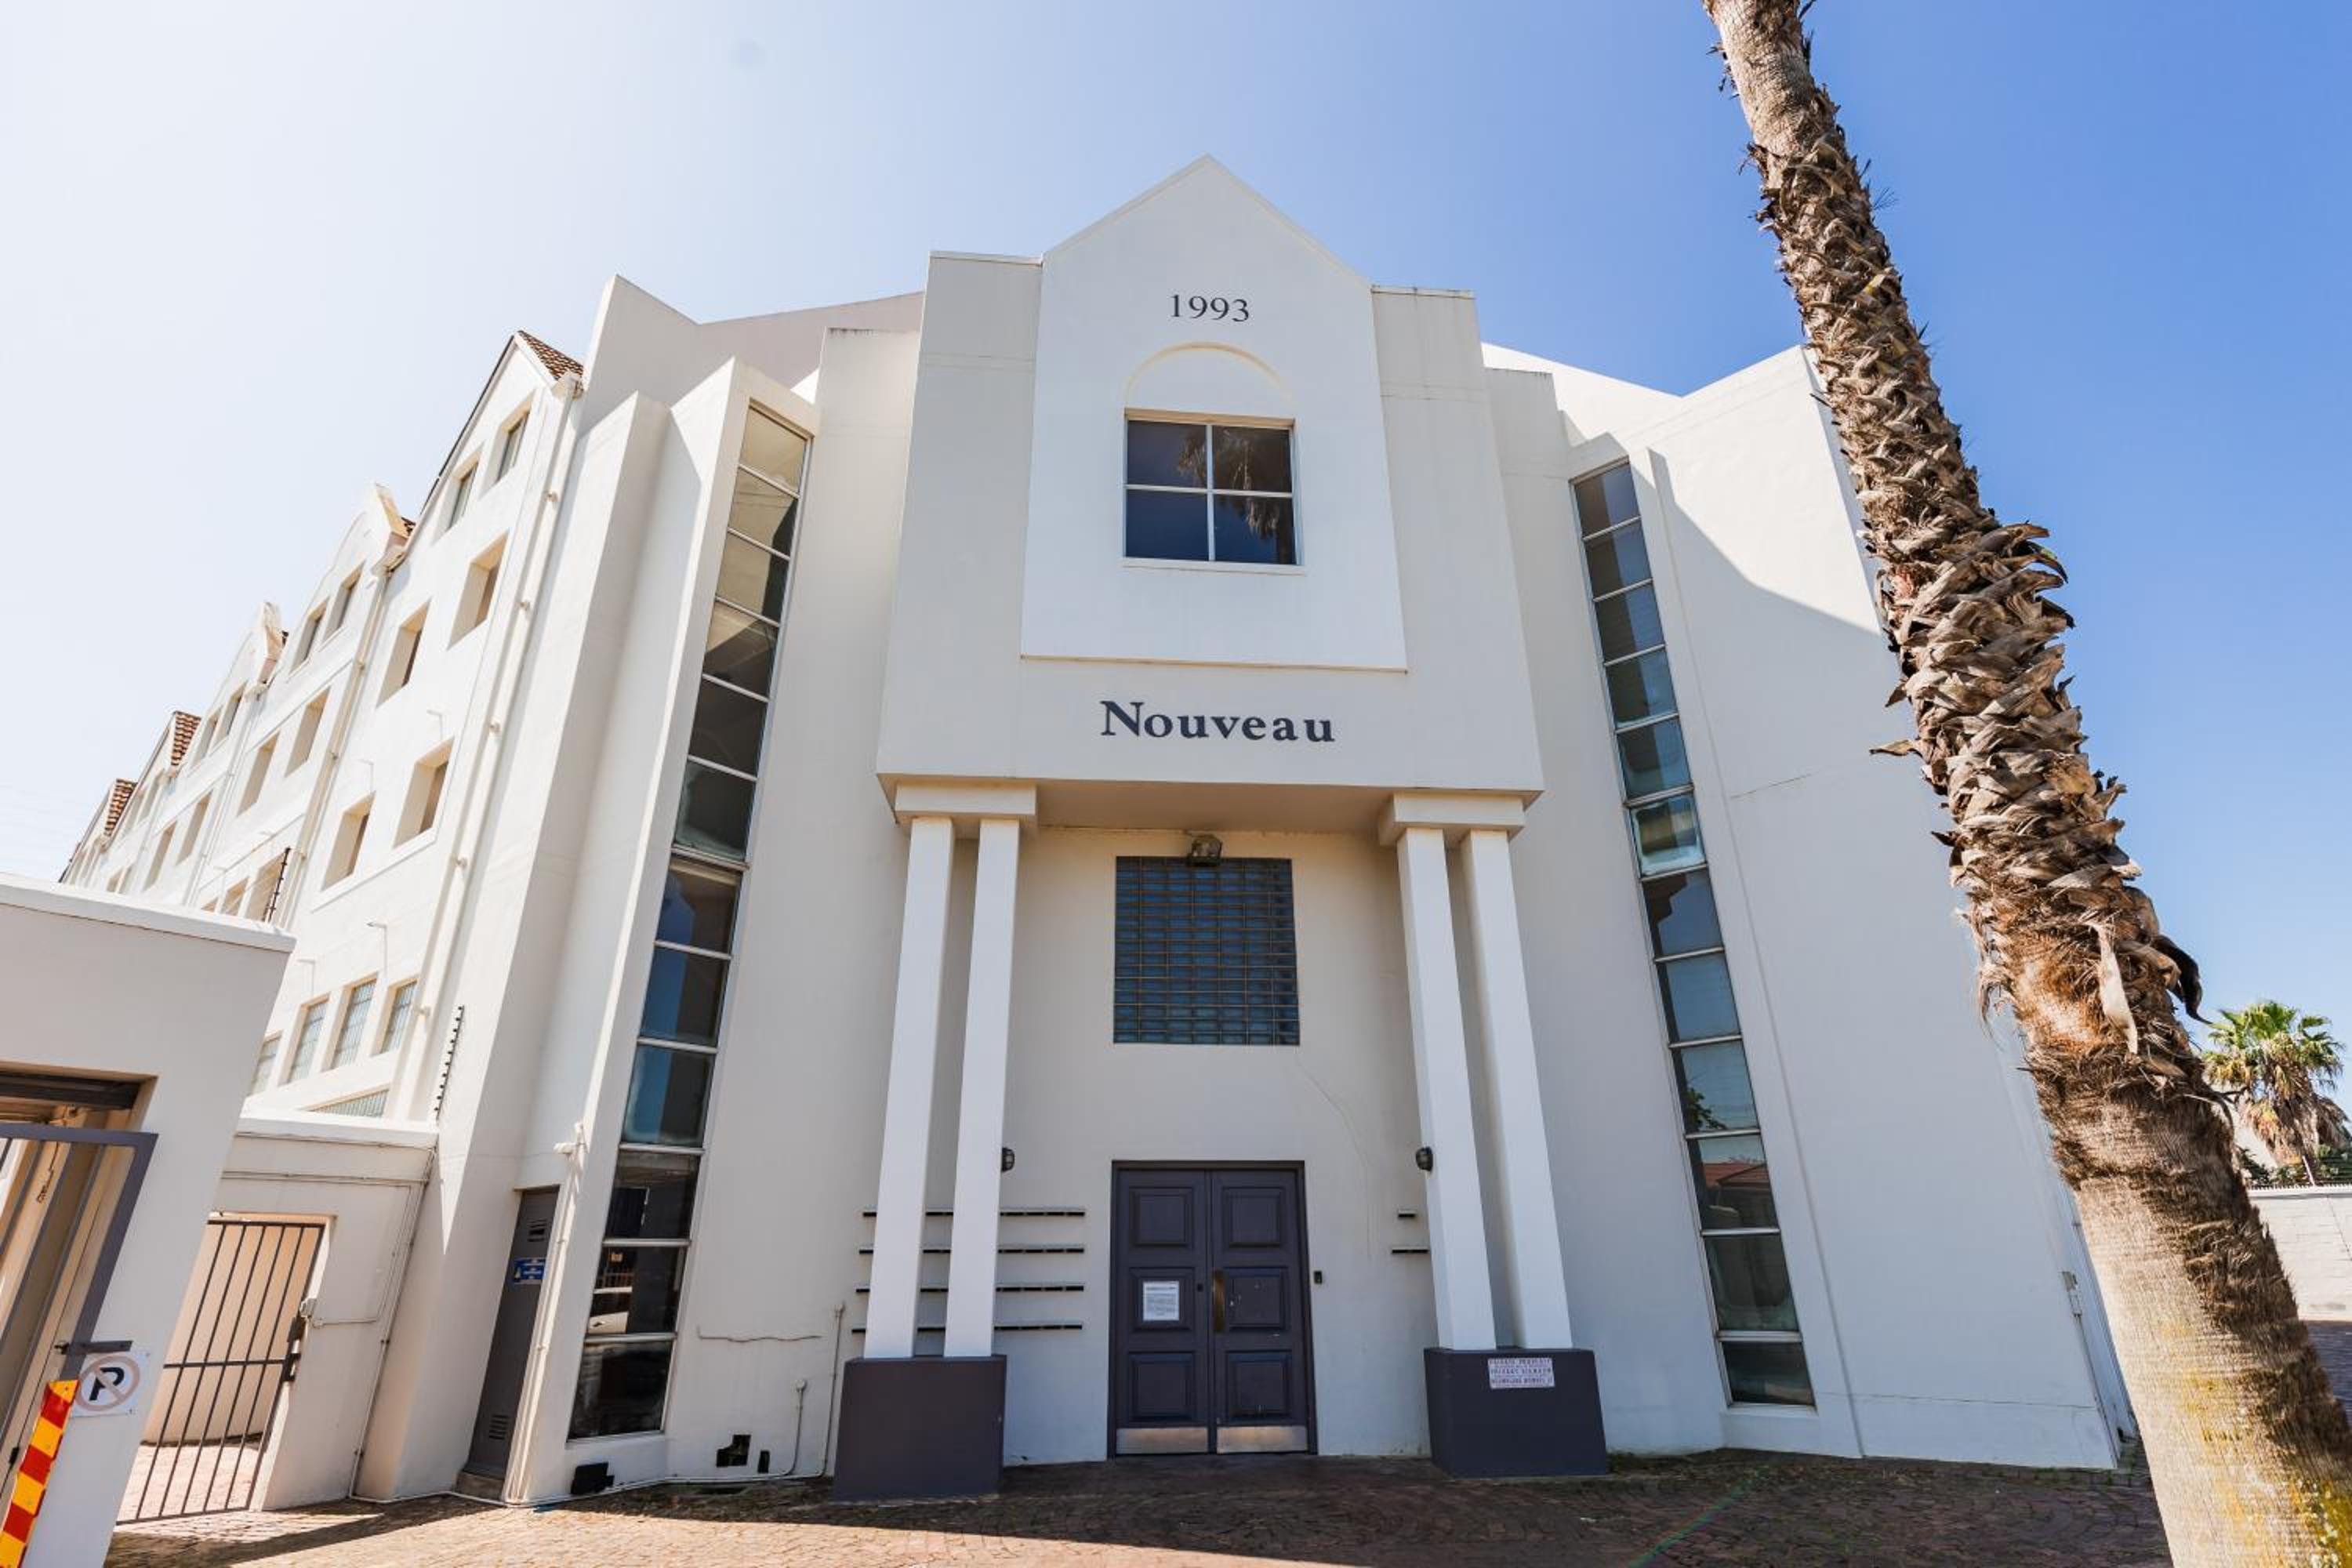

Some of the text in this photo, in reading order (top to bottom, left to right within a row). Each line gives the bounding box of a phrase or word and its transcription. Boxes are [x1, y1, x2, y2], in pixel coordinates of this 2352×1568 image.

[1171, 294, 1249, 322] 1993
[1100, 700, 1335, 742] Nouveau
[89, 1367, 125, 1401] P
